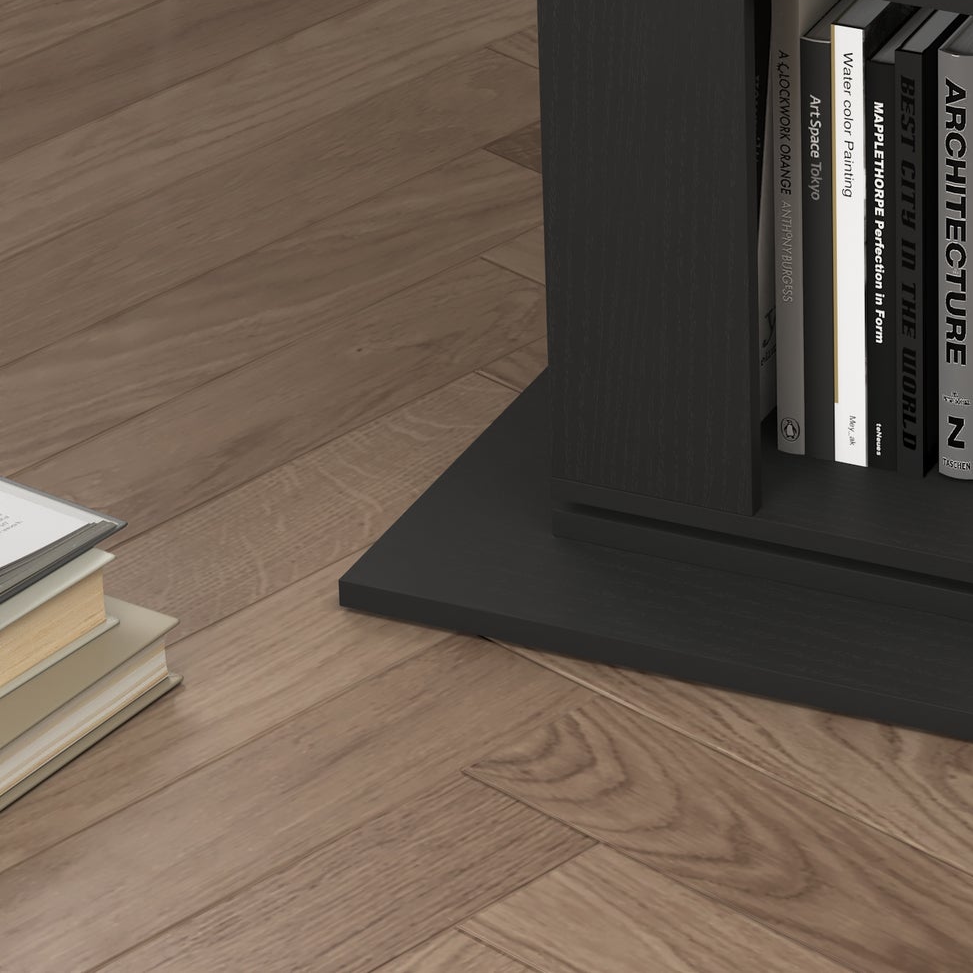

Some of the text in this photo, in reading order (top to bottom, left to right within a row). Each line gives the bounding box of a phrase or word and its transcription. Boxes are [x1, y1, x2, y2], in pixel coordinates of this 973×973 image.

[778, 49, 790, 59] A
[776, 62, 792, 140] CLOCKWORK
[841, 52, 855, 198] Water color Painting
[901, 74, 916, 153] BEST
[779, 143, 792, 196] ORANGE
[809, 162, 822, 201] Tokyo
[901, 159, 917, 231] CITY
[873, 101, 886, 344] MAPPLETHORPE Perfection in Form
[945, 77, 967, 366] ARCHITECTURE
[902, 282, 917, 339] THE
[902, 346, 917, 451] WORLD
[942, 457, 972, 470] TASCHEN
